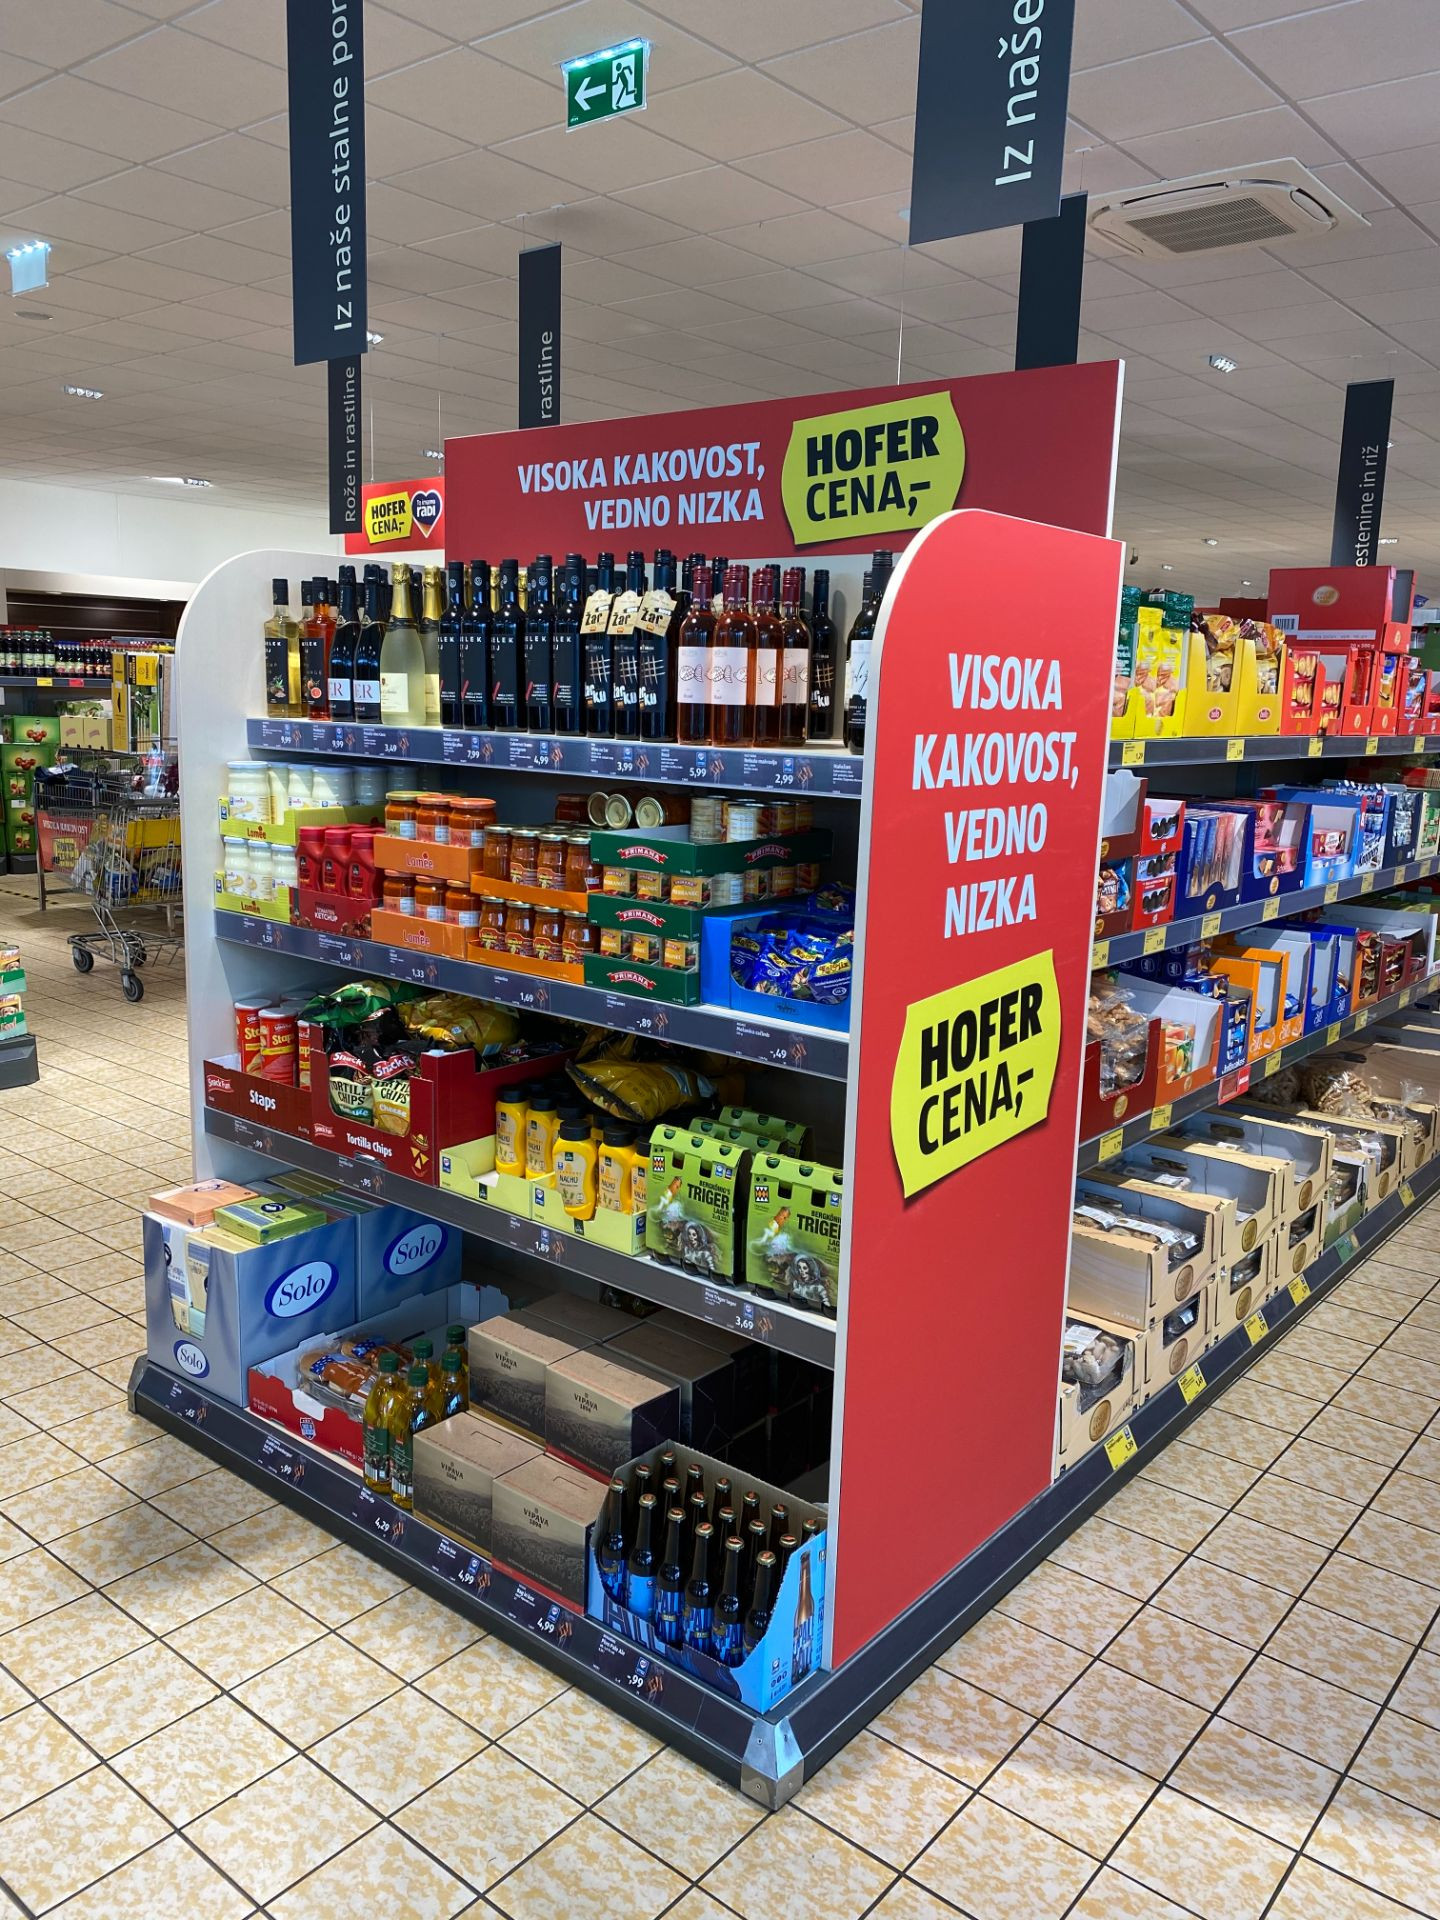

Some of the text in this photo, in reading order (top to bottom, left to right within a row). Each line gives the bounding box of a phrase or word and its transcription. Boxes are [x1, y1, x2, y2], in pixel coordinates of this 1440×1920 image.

[995, 0, 1045, 186] Iz naše
[328, 76, 350, 194] stalne
[330, 204, 351, 292] naše
[334, 302, 352, 331] Iz
[541, 331, 554, 420] rastline
[344, 367, 356, 522] Rože in rastline
[806, 415, 939, 477] HOFER
[1362, 444, 1379, 467] riž
[517, 441, 766, 494] VISOKA KAKOVOST,
[1359, 470, 1376, 488] in
[371, 499, 406, 520] HOFER
[584, 487, 765, 531] VEDNO NIZKA
[947, 652, 1063, 712] VISOKA
[912, 731, 1080, 790] KAKOVOST,
[689, 767, 707, 778] 5,99
[775, 774, 794, 785] 2,99
[943, 801, 1048, 864] VEDNO
[625, 847, 660, 861] PRIMANA
[943, 873, 1037, 938] NIZKA
[623, 910, 658, 925] PRIMANA
[614, 972, 649, 987] PRIMANA
[921, 981, 1043, 1090] HOFER
[249, 1089, 276, 1111] Staps
[337, 1091, 366, 1106] CHIPS
[380, 1087, 410, 1104] CHIPS
[346, 1132, 393, 1157] Tortilla Chips
[687, 1183, 730, 1211] TRIGER
[395, 1235, 436, 1266] Solo
[279, 1274, 326, 1308] Solo
[735, 1315, 754, 1329] 3,69
[180, 1347, 203, 1370] Solo
[495, 1351, 518, 1368] VIPAVA
[574, 1392, 598, 1411] VIPAVA
[441, 1462, 464, 1479] VIPAVA
[374, 1517, 390, 1531] 4,29
[524, 1507, 549, 1527] VIPAVA
[458, 1569, 475, 1585] 4,99
[537, 1617, 555, 1633] 4,99
